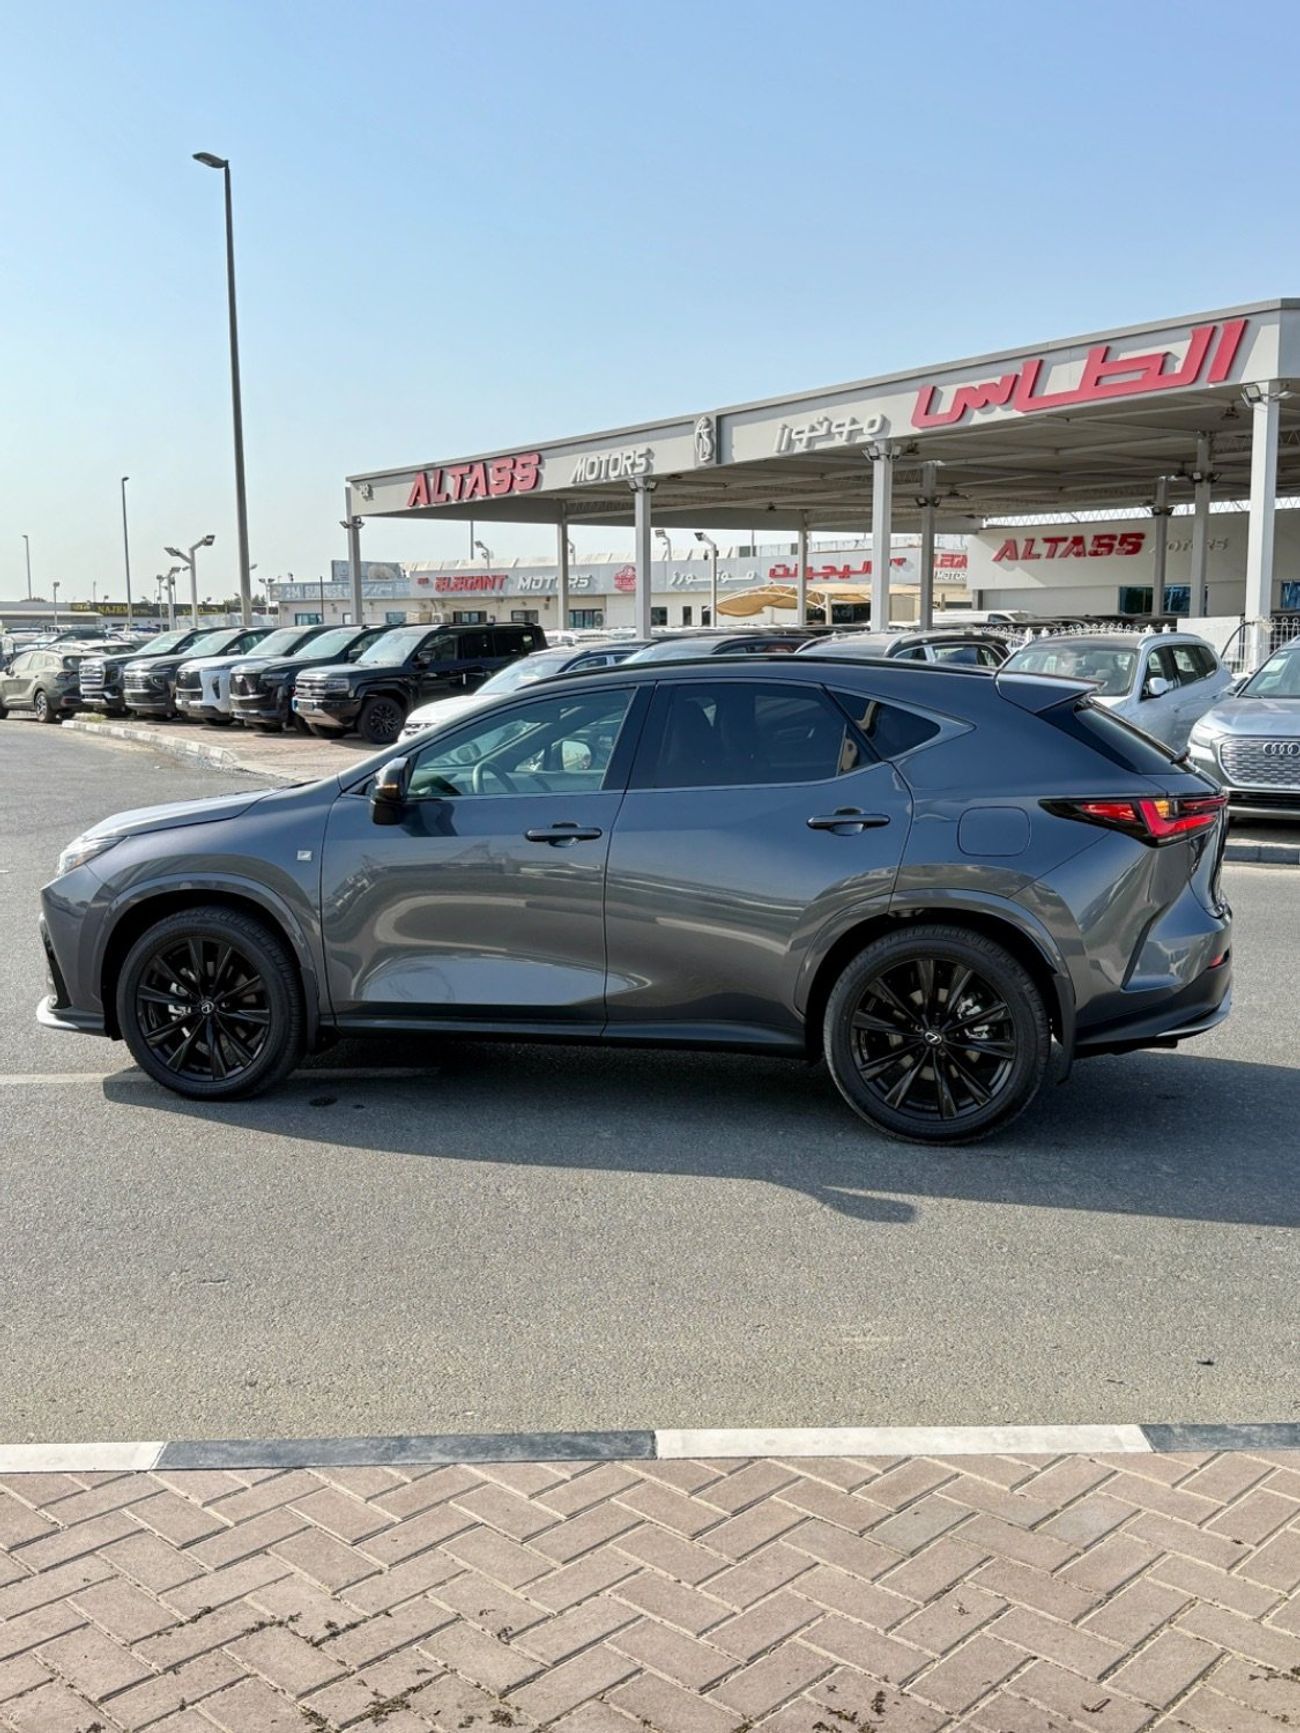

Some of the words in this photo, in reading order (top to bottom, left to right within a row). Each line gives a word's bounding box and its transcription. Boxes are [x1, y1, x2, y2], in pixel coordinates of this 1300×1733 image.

[911, 319, 1249, 429] الطاس
[408, 452, 541, 508] ALTASS
[571, 446, 655, 485] MOTORS
[992, 532, 1146, 562] ALTASS
[434, 574, 509, 592] ELEGANT
